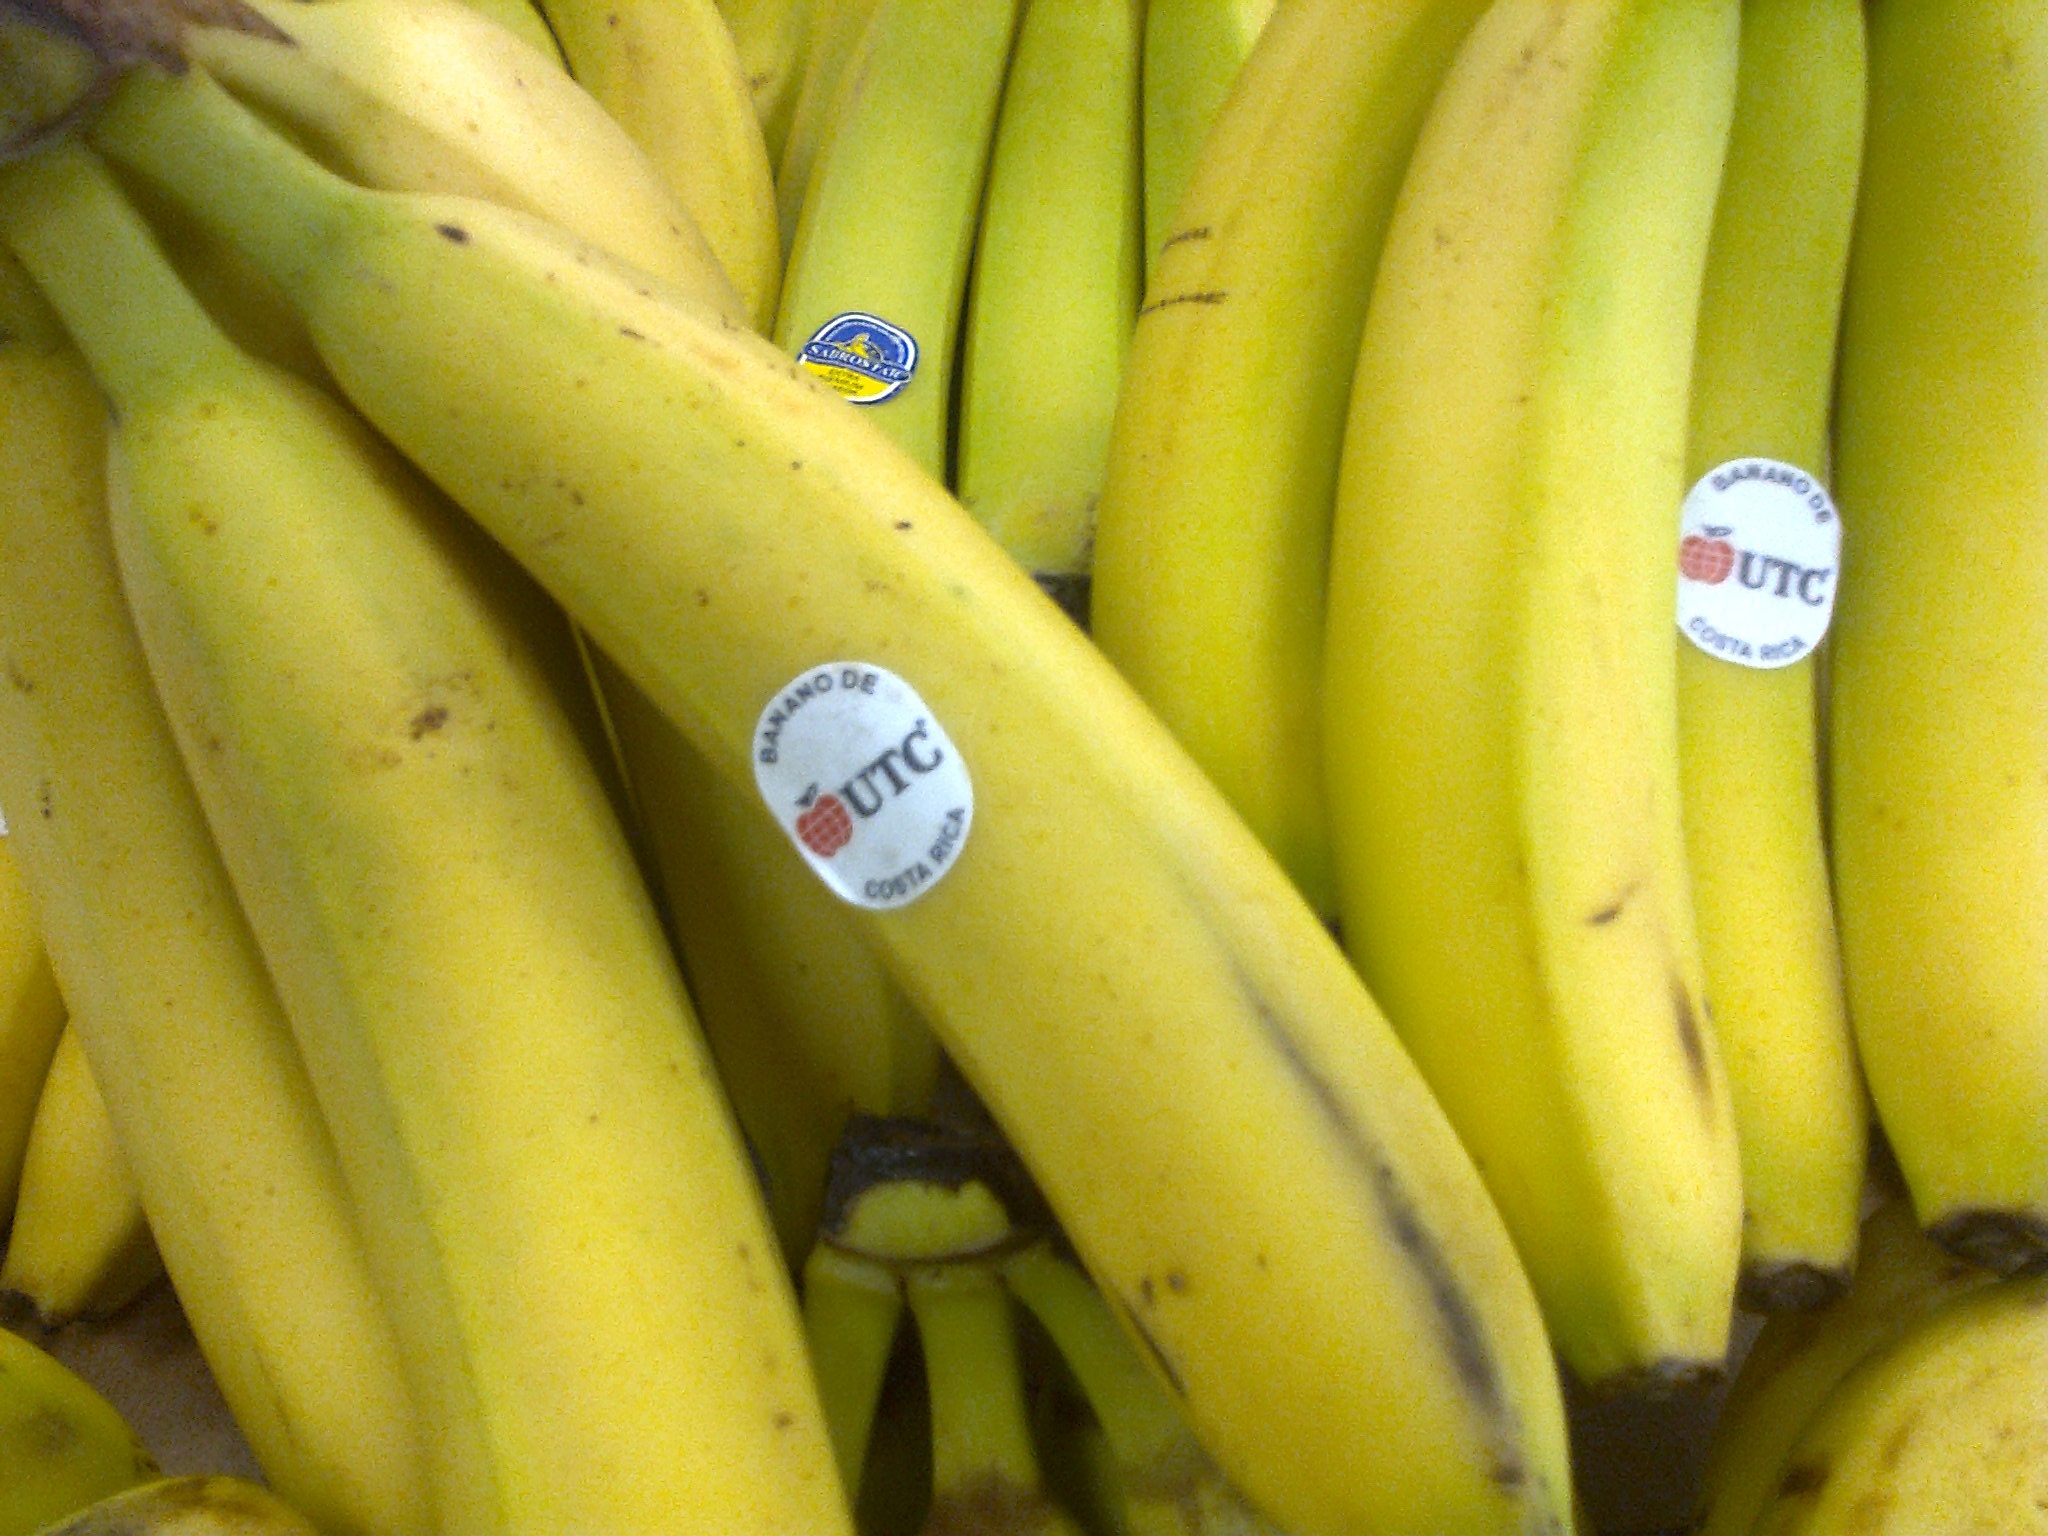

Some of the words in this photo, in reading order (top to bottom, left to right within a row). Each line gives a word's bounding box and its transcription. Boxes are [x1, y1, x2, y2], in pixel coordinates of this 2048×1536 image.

[808, 344, 904, 380] SABROSTAR
[1711, 464, 1811, 492] BANANO
[1808, 493, 1832, 523] DE
[1740, 550, 1831, 607] UTC
[1689, 616, 1752, 659] COSTA
[1760, 635, 1807, 661] RICA
[758, 673, 834, 764] BANANO
[841, 669, 880, 695] DE
[839, 722, 944, 819] UTC
[864, 862, 933, 900] COSTA
[930, 808, 965, 864] RICA
